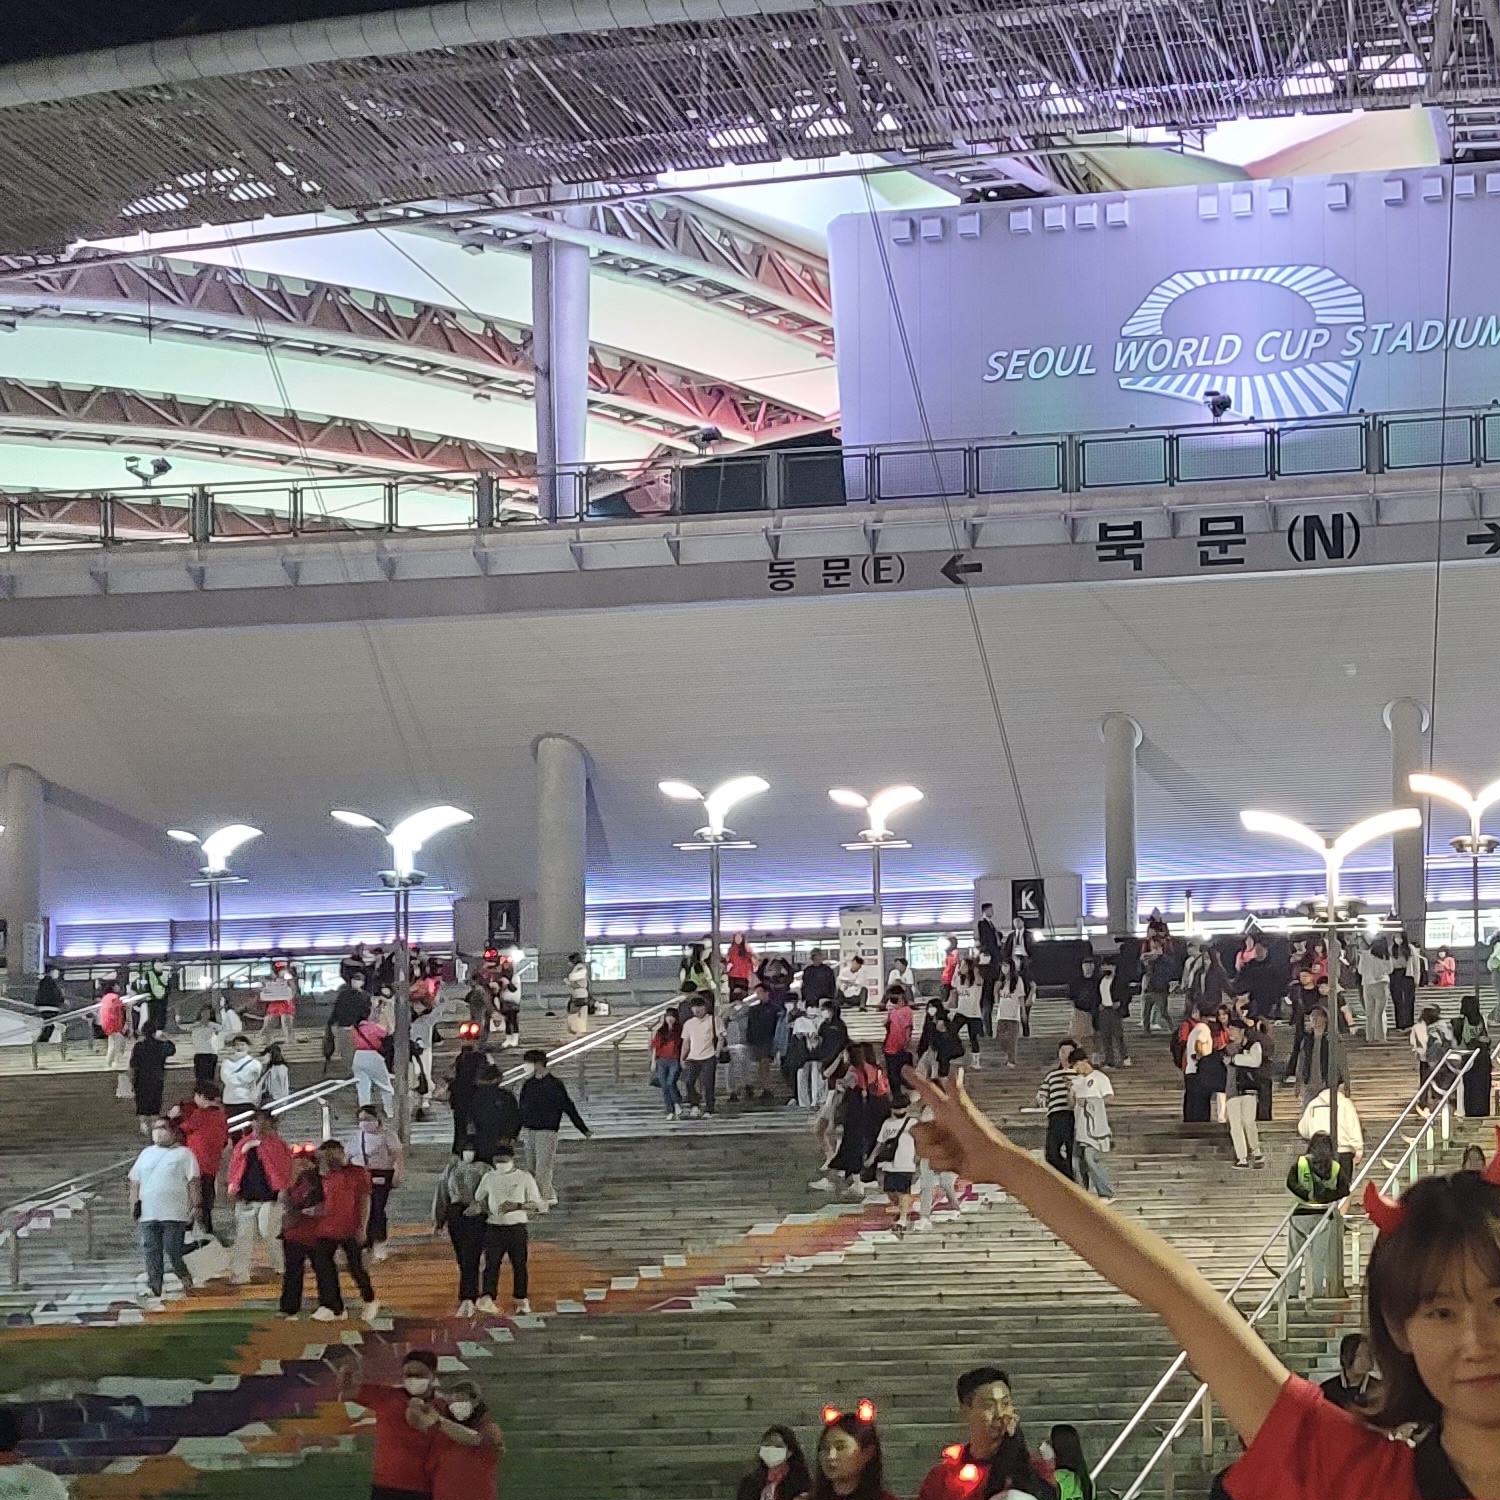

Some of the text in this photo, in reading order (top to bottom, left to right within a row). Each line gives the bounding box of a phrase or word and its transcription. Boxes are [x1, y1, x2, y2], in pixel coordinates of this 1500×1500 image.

[982, 344, 1097, 383] SEOUL
[1113, 333, 1242, 373] WORLD
[1255, 327, 1331, 363] CUP
[1021, 890, 1036, 910] K
[499, 911, 507, 931] J
